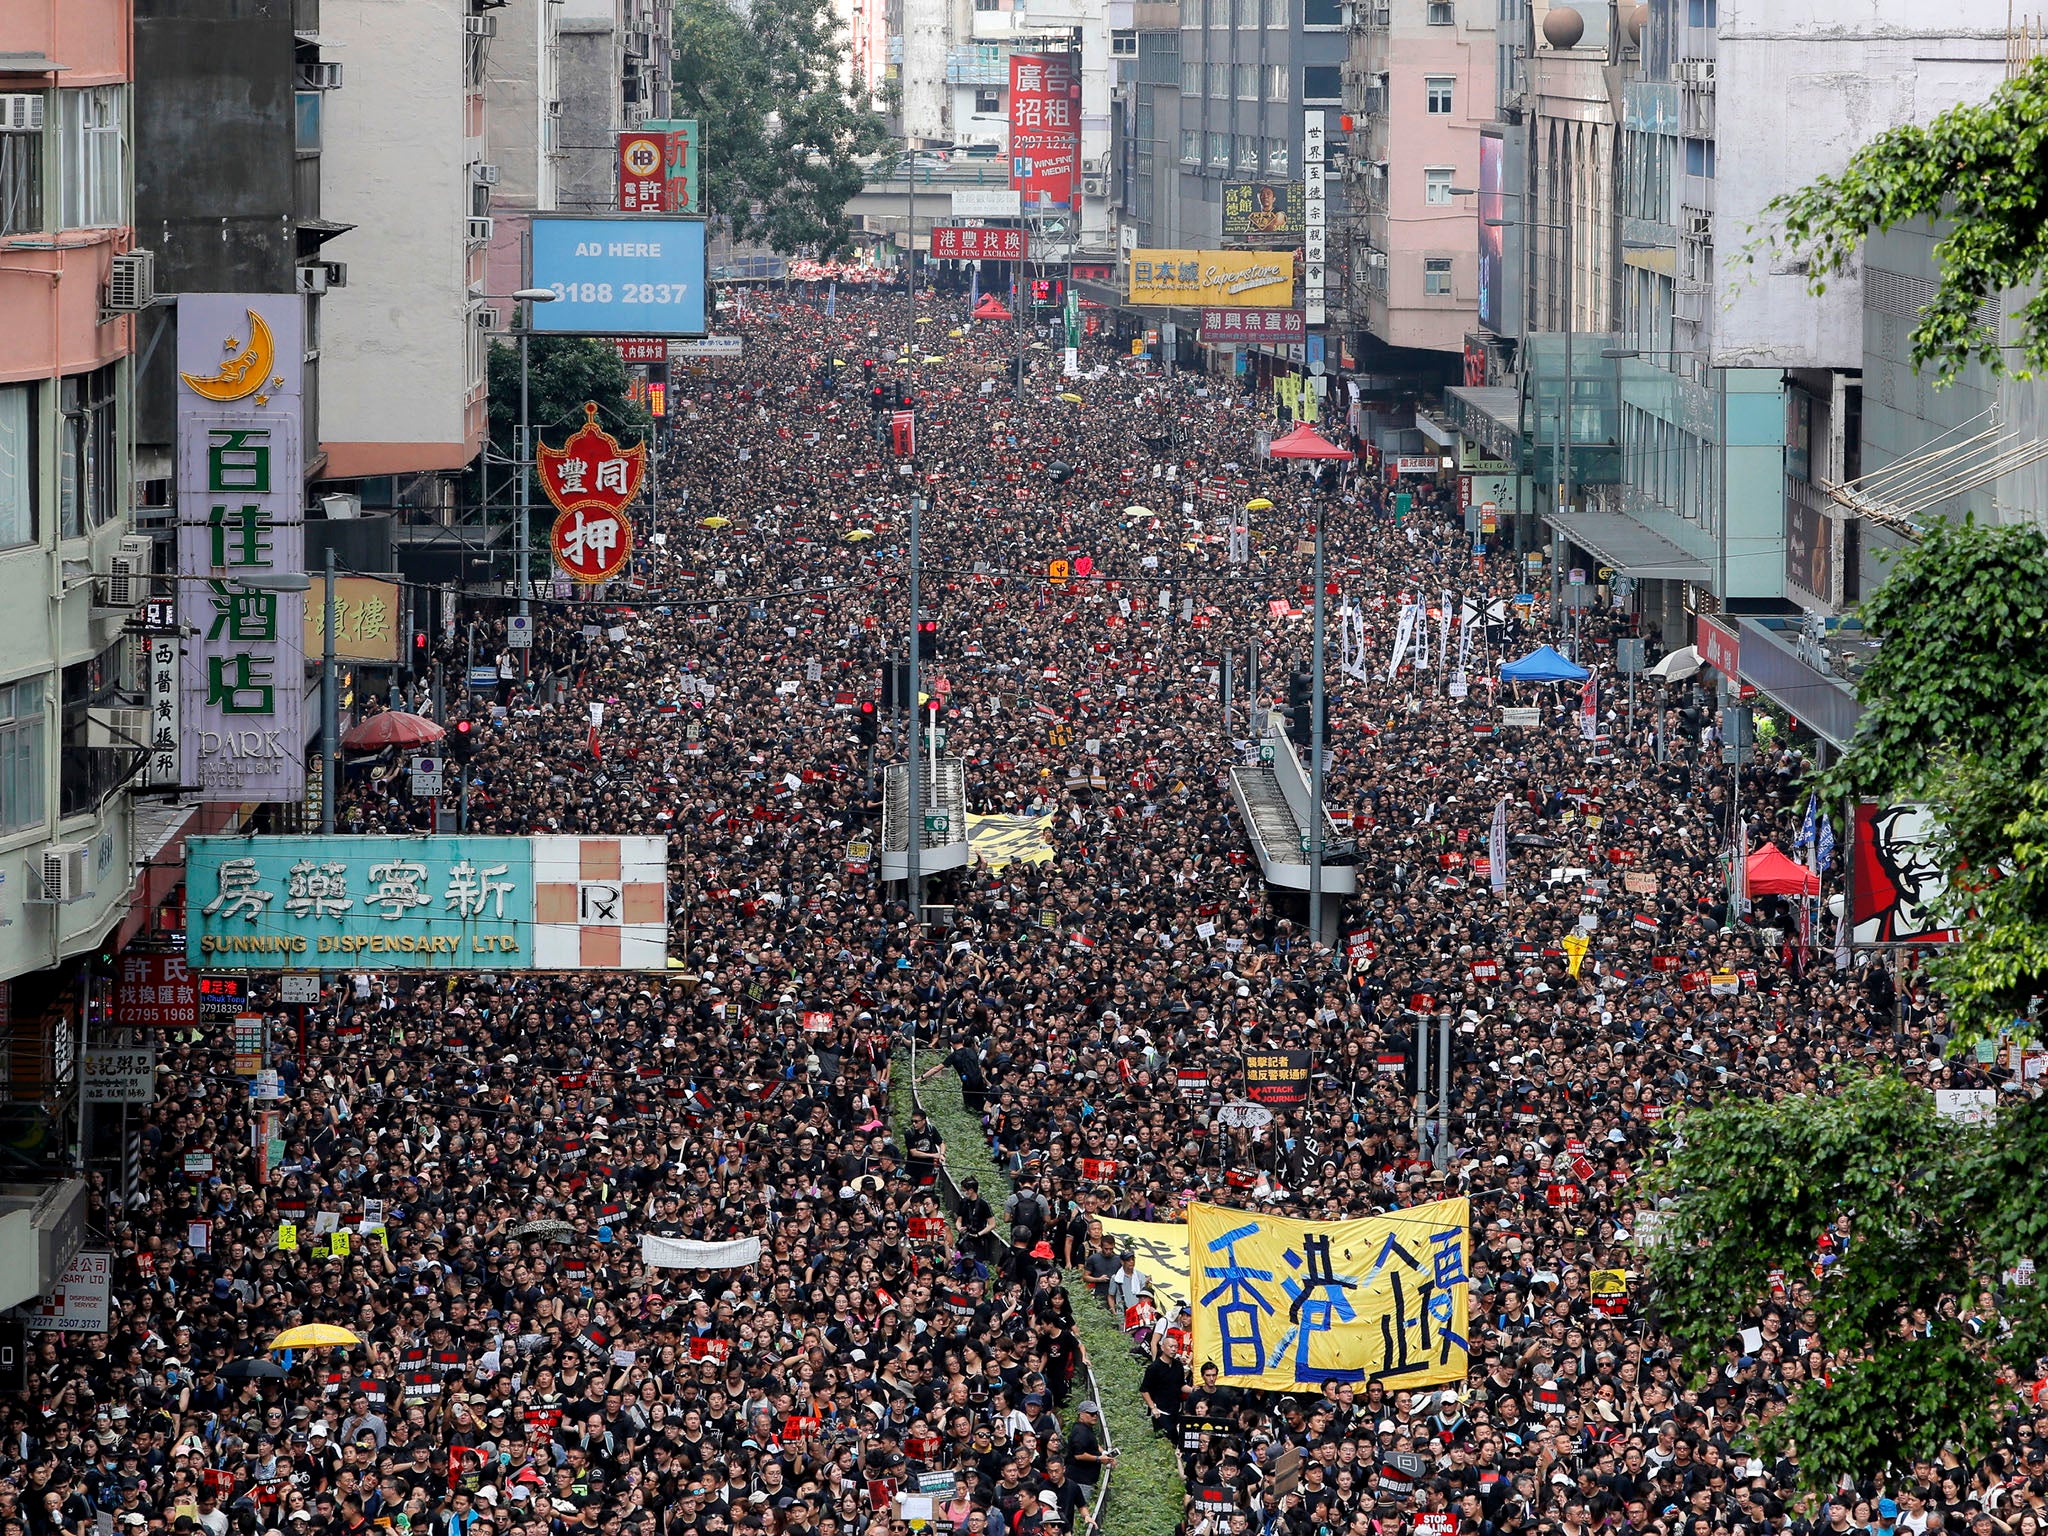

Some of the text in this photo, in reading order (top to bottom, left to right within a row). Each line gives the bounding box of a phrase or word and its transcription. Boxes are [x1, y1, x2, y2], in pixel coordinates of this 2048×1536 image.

[1015, 64, 1070, 93] 廣告
[1015, 98, 1070, 127] 招租
[633, 150, 653, 166] HB
[1041, 165, 1071, 177] MEDIA
[624, 182, 637, 208] 電話
[939, 230, 1021, 250] 港豐找換
[574, 242, 662, 257] AD HERE
[939, 249, 1021, 258] KONG FUNG EXCHANGE
[1134, 261, 1200, 282] 日本城
[1201, 263, 1281, 294] Superstore
[550, 282, 688, 304] 3188 2837
[1205, 312, 1302, 331] 潮興魚蛋粉
[1465, 440, 1476, 454] P
[1400, 457, 1436, 468] 皇冠眼鏡
[1479, 460, 1493, 469] LEI
[561, 510, 619, 569] 押
[206, 427, 278, 715] 百佳酒店
[198, 730, 284, 759] PARK
[199, 762, 284, 775] EXCELLENT
[198, 774, 245, 788] HOTEL
[430, 775, 437, 783] 7
[431, 787, 441, 795] 12
[200, 934, 307, 954] SUNNING
[316, 934, 461, 954] DISPENSARY
[471, 934, 520, 954] LTD.
[123, 957, 189, 983] 許氏
[305, 978, 313, 987] 7
[119, 984, 195, 1005] 找換匯款
[305, 992, 319, 1002] 12
[162, 1007, 195, 1022] 1968
[1246, 1055, 1290, 1068] 襲擊記者
[1247, 1068, 1308, 1081] 違反警察通例
[1261, 1085, 1294, 1093] ATTACK
[280, 1226, 295, 1243] 港
[89, 1275, 104, 1285] LTD
[69, 1294, 103, 1302] DISPENSING
[73, 1301, 98, 1309] SERVICE
[58, 1319, 79, 1328] 2507
[80, 1319, 101, 1329] 3737
[1423, 1514, 1448, 1524] STOP
